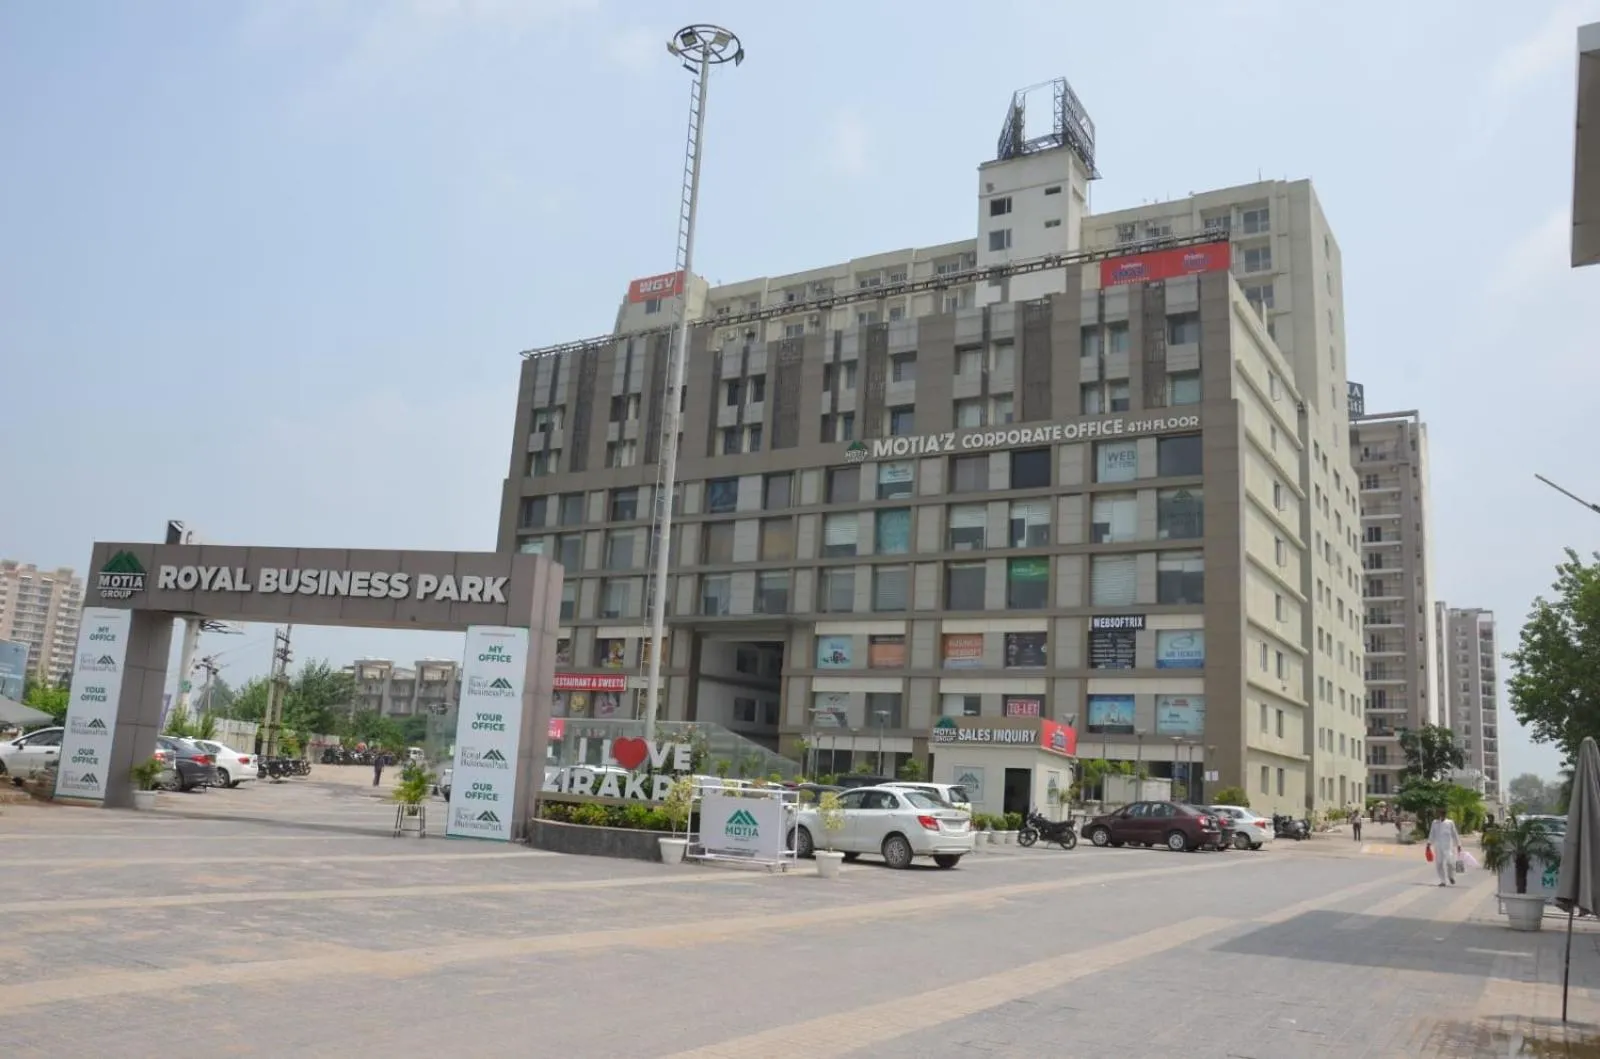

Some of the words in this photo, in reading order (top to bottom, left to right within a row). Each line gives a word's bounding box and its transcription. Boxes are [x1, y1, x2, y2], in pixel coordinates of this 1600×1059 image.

[639, 277, 675, 293] WGV
[873, 432, 956, 457] MOTIA'Z
[962, 425, 1063, 449] CORPORATE
[1064, 418, 1123, 439] OFFICE
[1153, 415, 1199, 431] FLOOR
[98, 575, 144, 588] MOTIA
[158, 565, 252, 592] ROYAL
[258, 567, 409, 598] BUSINESS
[416, 573, 508, 604] PARK
[100, 590, 132, 600] GROUP
[1093, 616, 1143, 628] WEBSOFTRIX
[89, 633, 117, 642] OFFICE
[488, 645, 504, 654] MY
[478, 653, 512, 663] OFFICE
[598, 678, 624, 688] SWEETS
[84, 686, 106, 694] YOUR
[80, 693, 108, 702] OFFICE
[476, 712, 503, 722] YOUR
[471, 721, 505, 732] OFFICE
[958, 728, 990, 742] SALES
[993, 729, 1036, 743] INQUIRY
[78, 748, 95, 756] OUR
[71, 755, 99, 765] OFFICE
[472, 782, 493, 792] OUR
[464, 790, 499, 801] OFFICE
[725, 826, 759, 837] MOTIA
